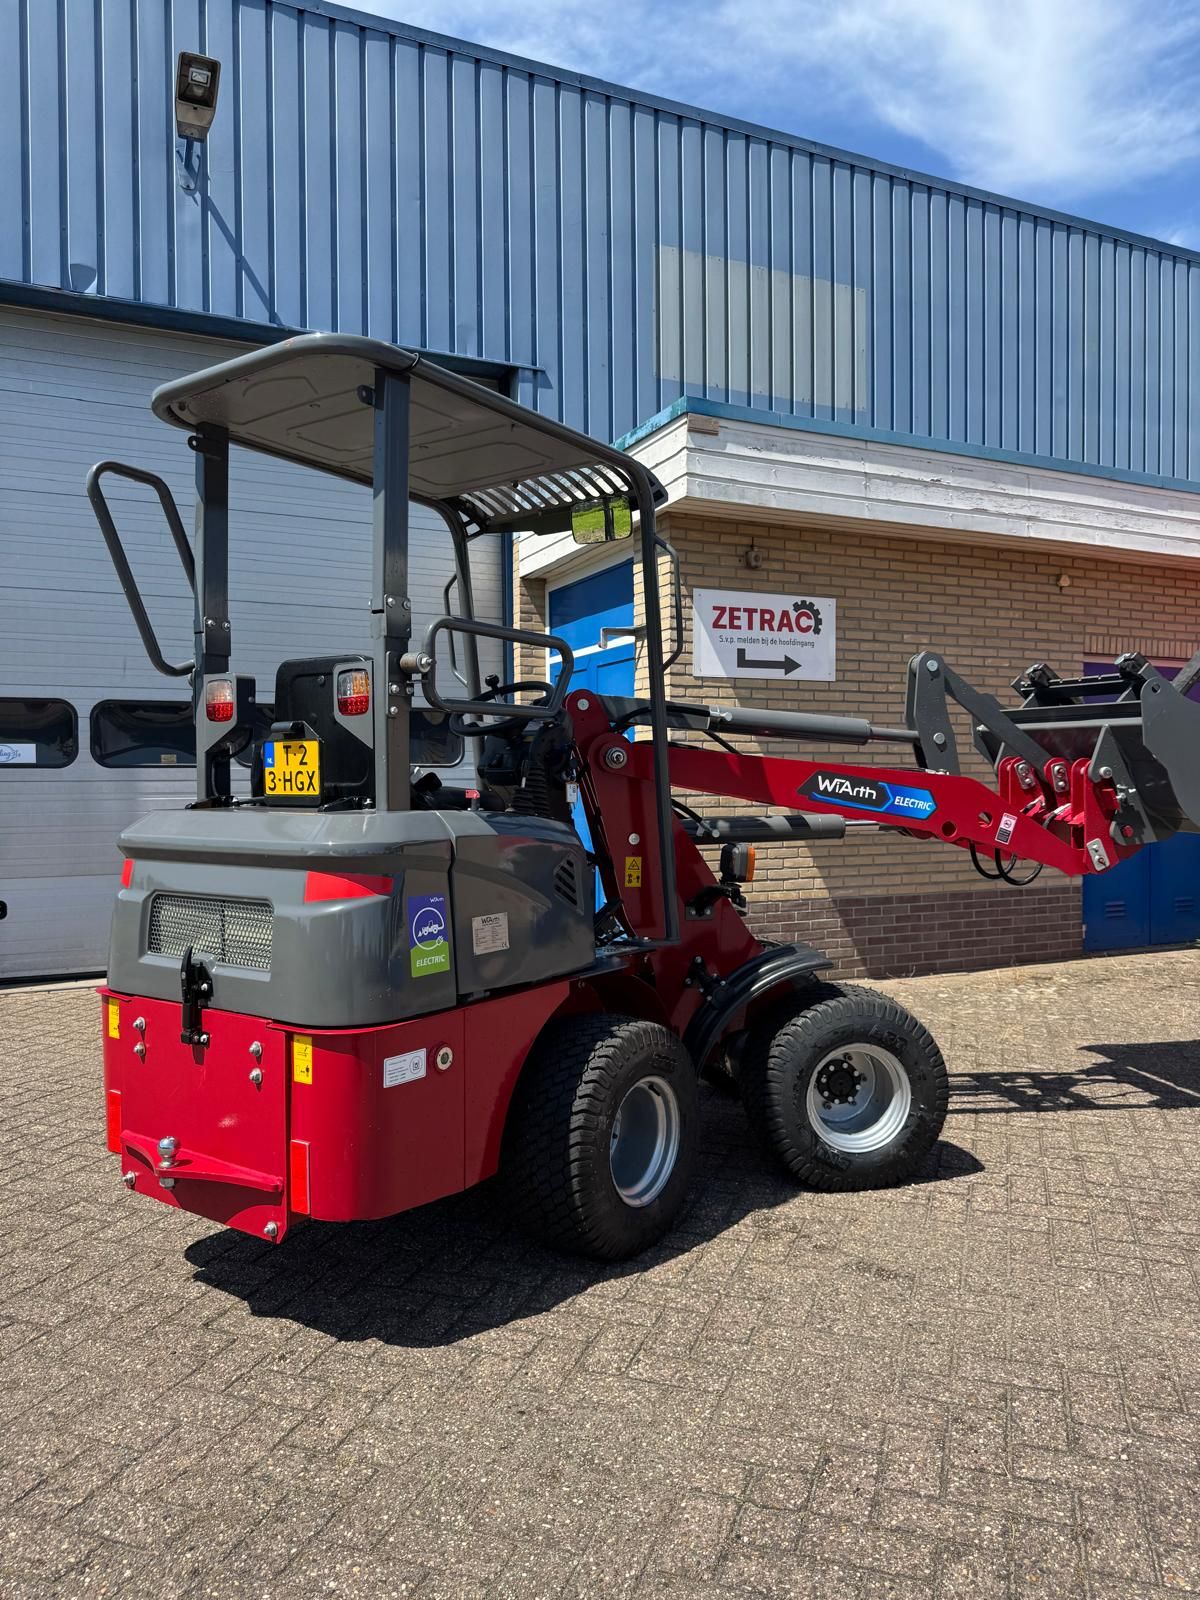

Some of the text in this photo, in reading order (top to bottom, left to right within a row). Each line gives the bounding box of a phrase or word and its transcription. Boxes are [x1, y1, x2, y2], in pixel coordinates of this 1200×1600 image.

[712, 605, 813, 633] ZETRAC
[719, 635, 815, 648] S.v.p. melden bij de hoofdingang
[817, 775, 933, 811] WiArth ELECTRIC
[416, 954, 446, 968] ELECTRIC
